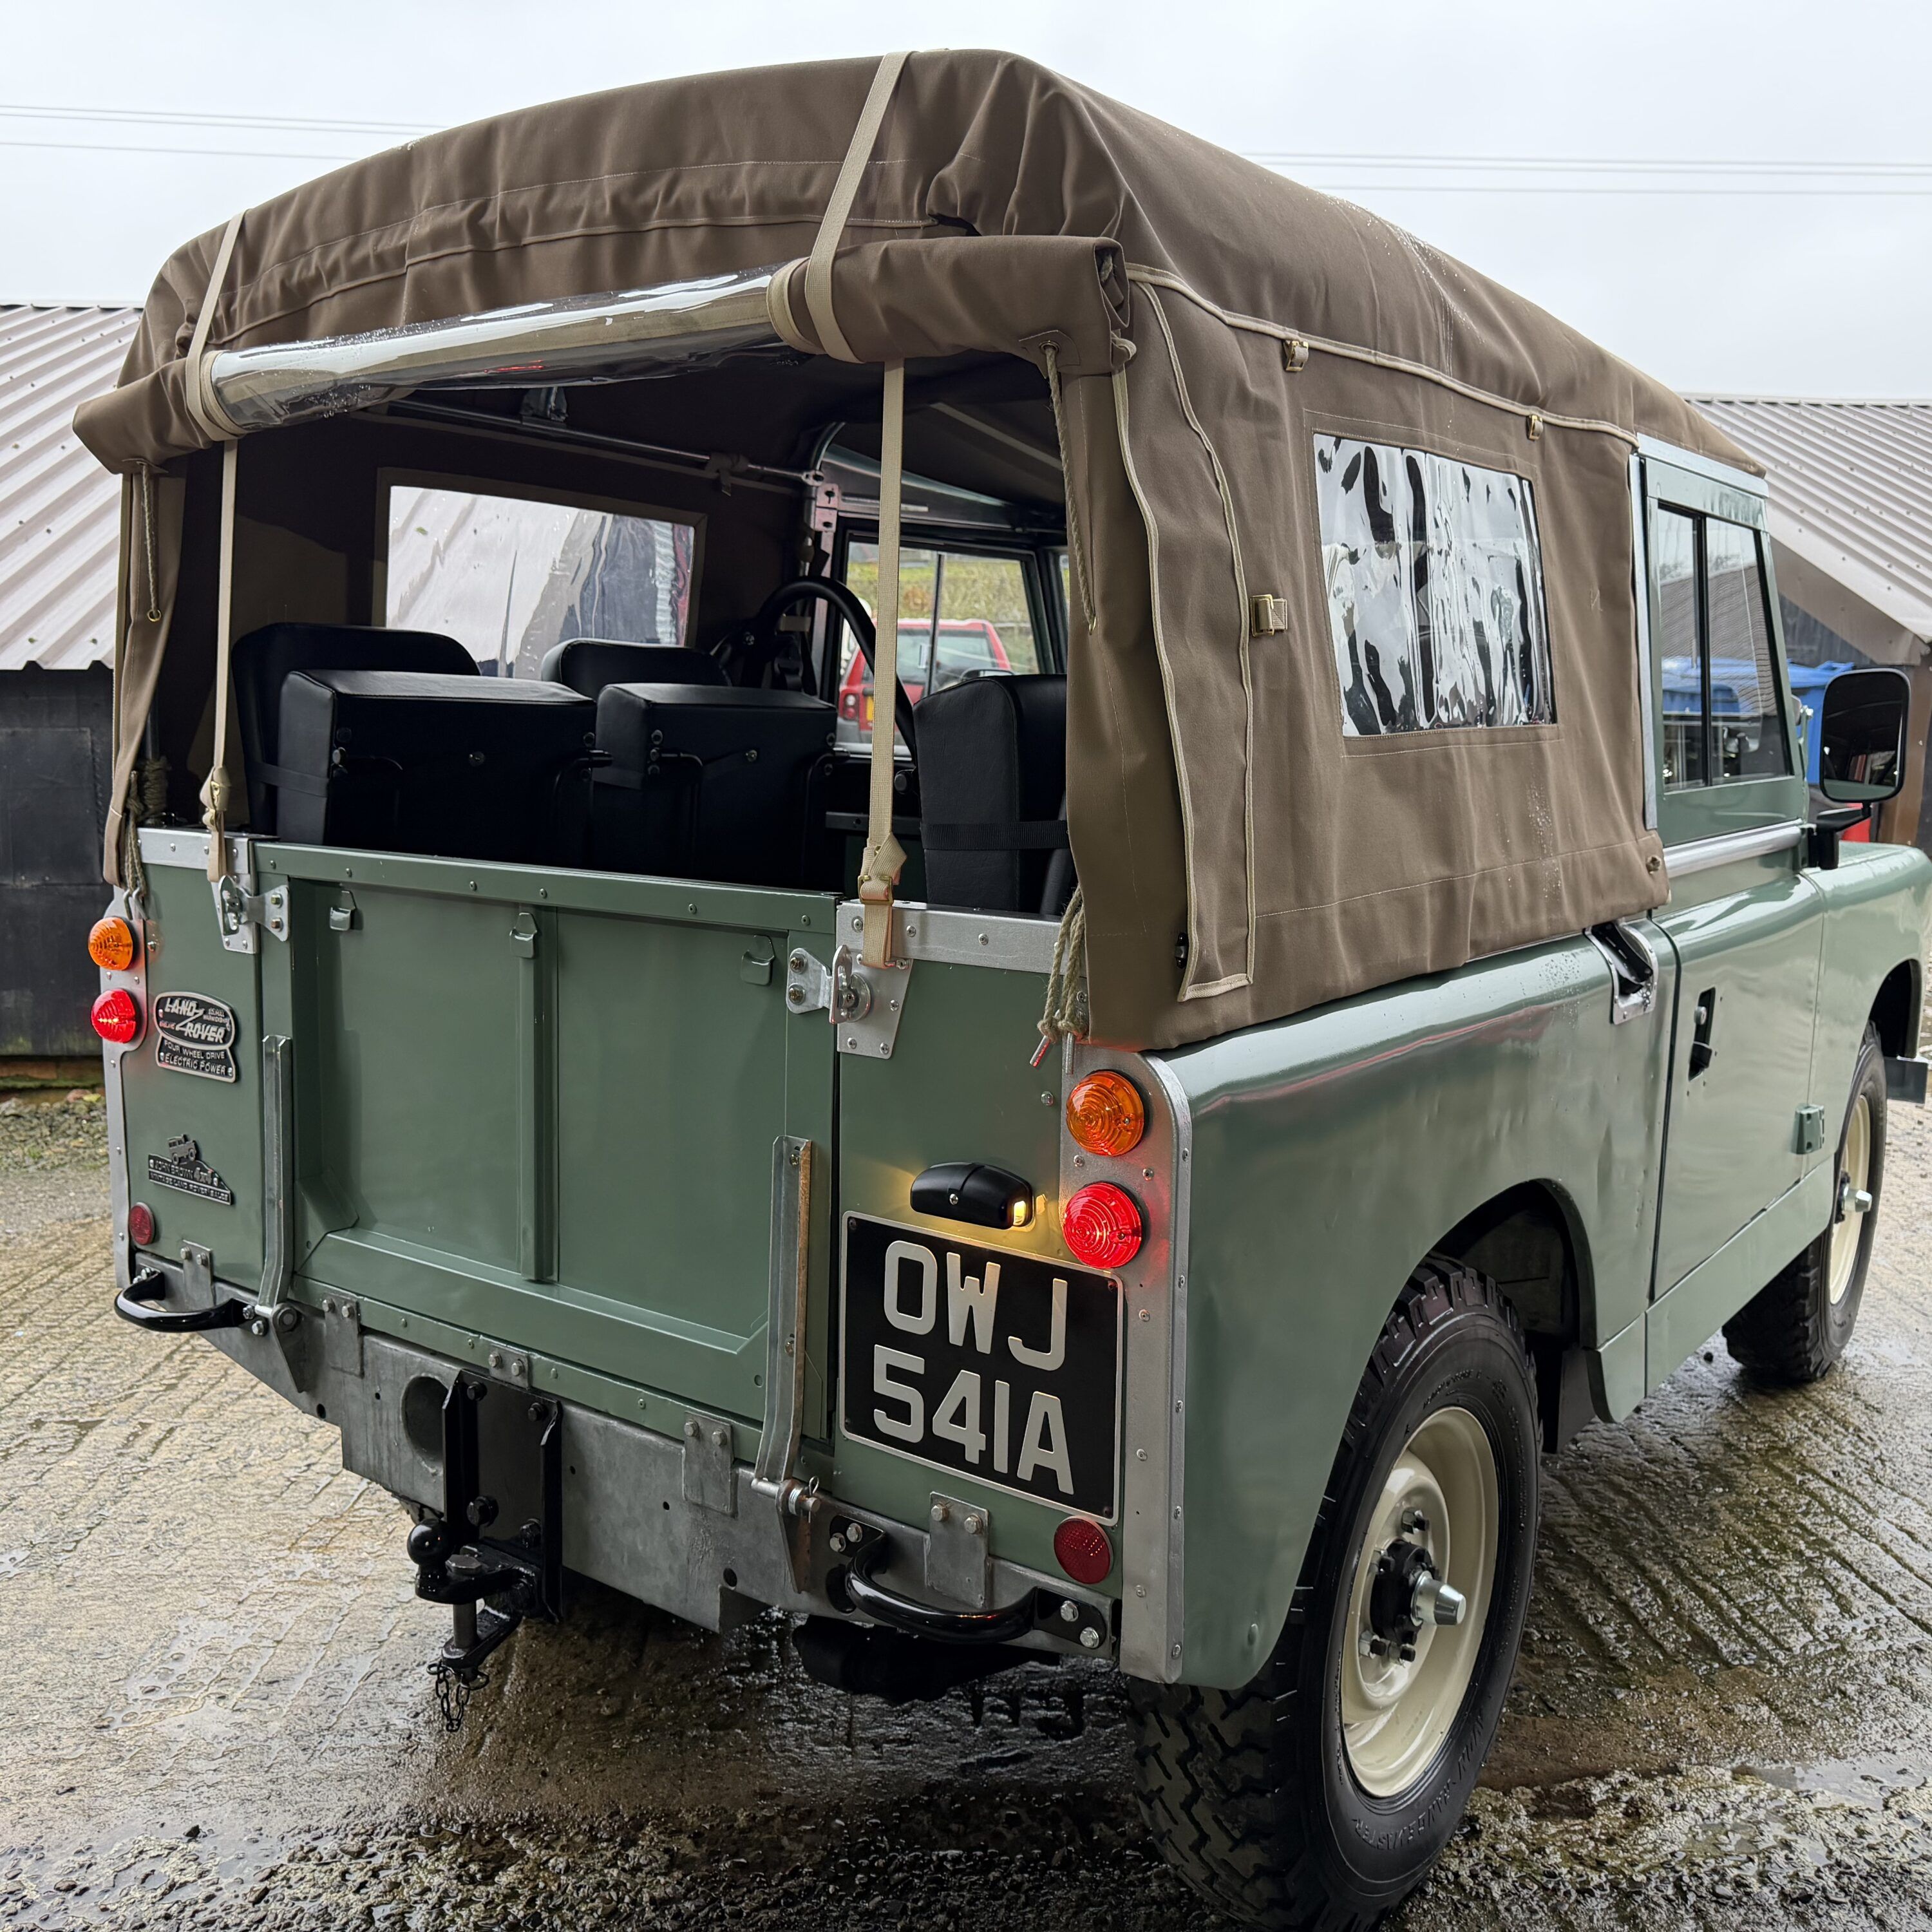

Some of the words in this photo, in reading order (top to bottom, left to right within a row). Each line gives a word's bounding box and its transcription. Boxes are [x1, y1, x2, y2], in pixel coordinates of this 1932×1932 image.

[165, 998, 197, 1016] LAND
[185, 1022, 225, 1043] ROVER
[165, 1040, 181, 1053] FOUR
[182, 1048, 204, 1059] WHEEL
[206, 1050, 225, 1059] DRIVE
[165, 1053, 198, 1069] ELECTRIC
[200, 1061, 226, 1075] POWER
[884, 1240, 1067, 1371] OWJ
[874, 1344, 1074, 1495] 541A
